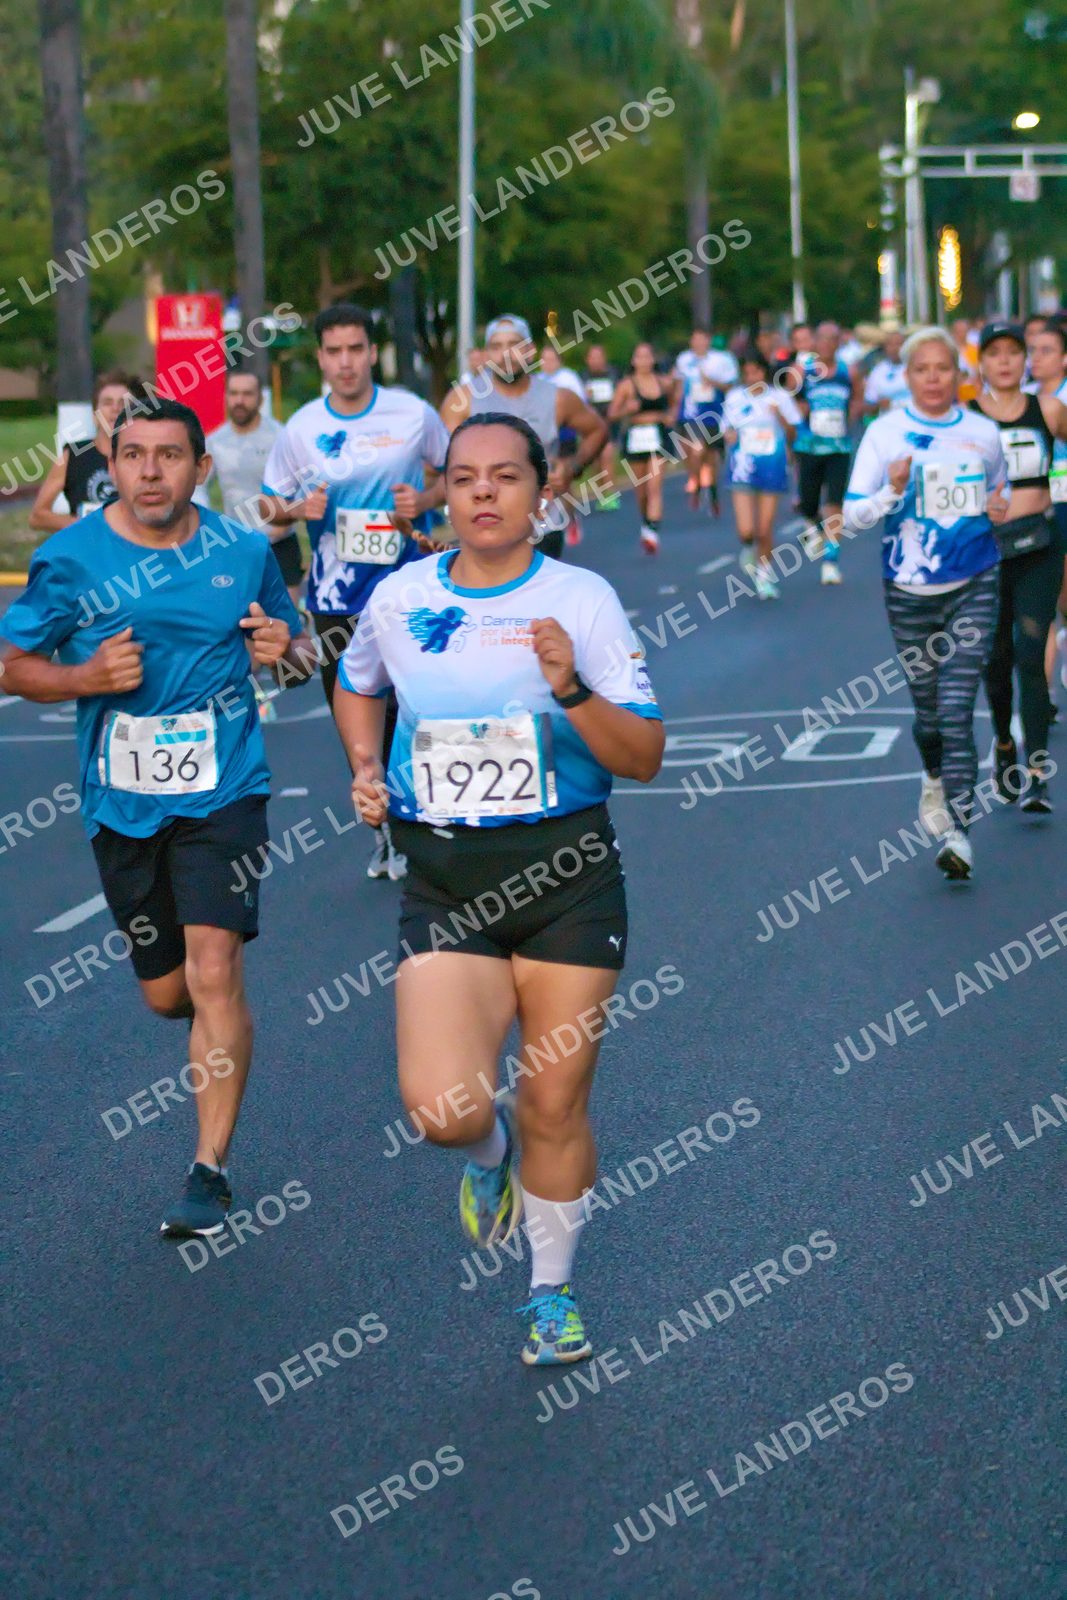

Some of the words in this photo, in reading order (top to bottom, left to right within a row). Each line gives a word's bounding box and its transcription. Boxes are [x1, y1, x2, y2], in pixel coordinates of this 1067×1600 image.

[935, 485, 980, 511] 301
[340, 531, 398, 556] 1386
[481, 615, 534, 626] Carrer
[128, 747, 199, 782] 136
[420, 758, 536, 803] 1922
